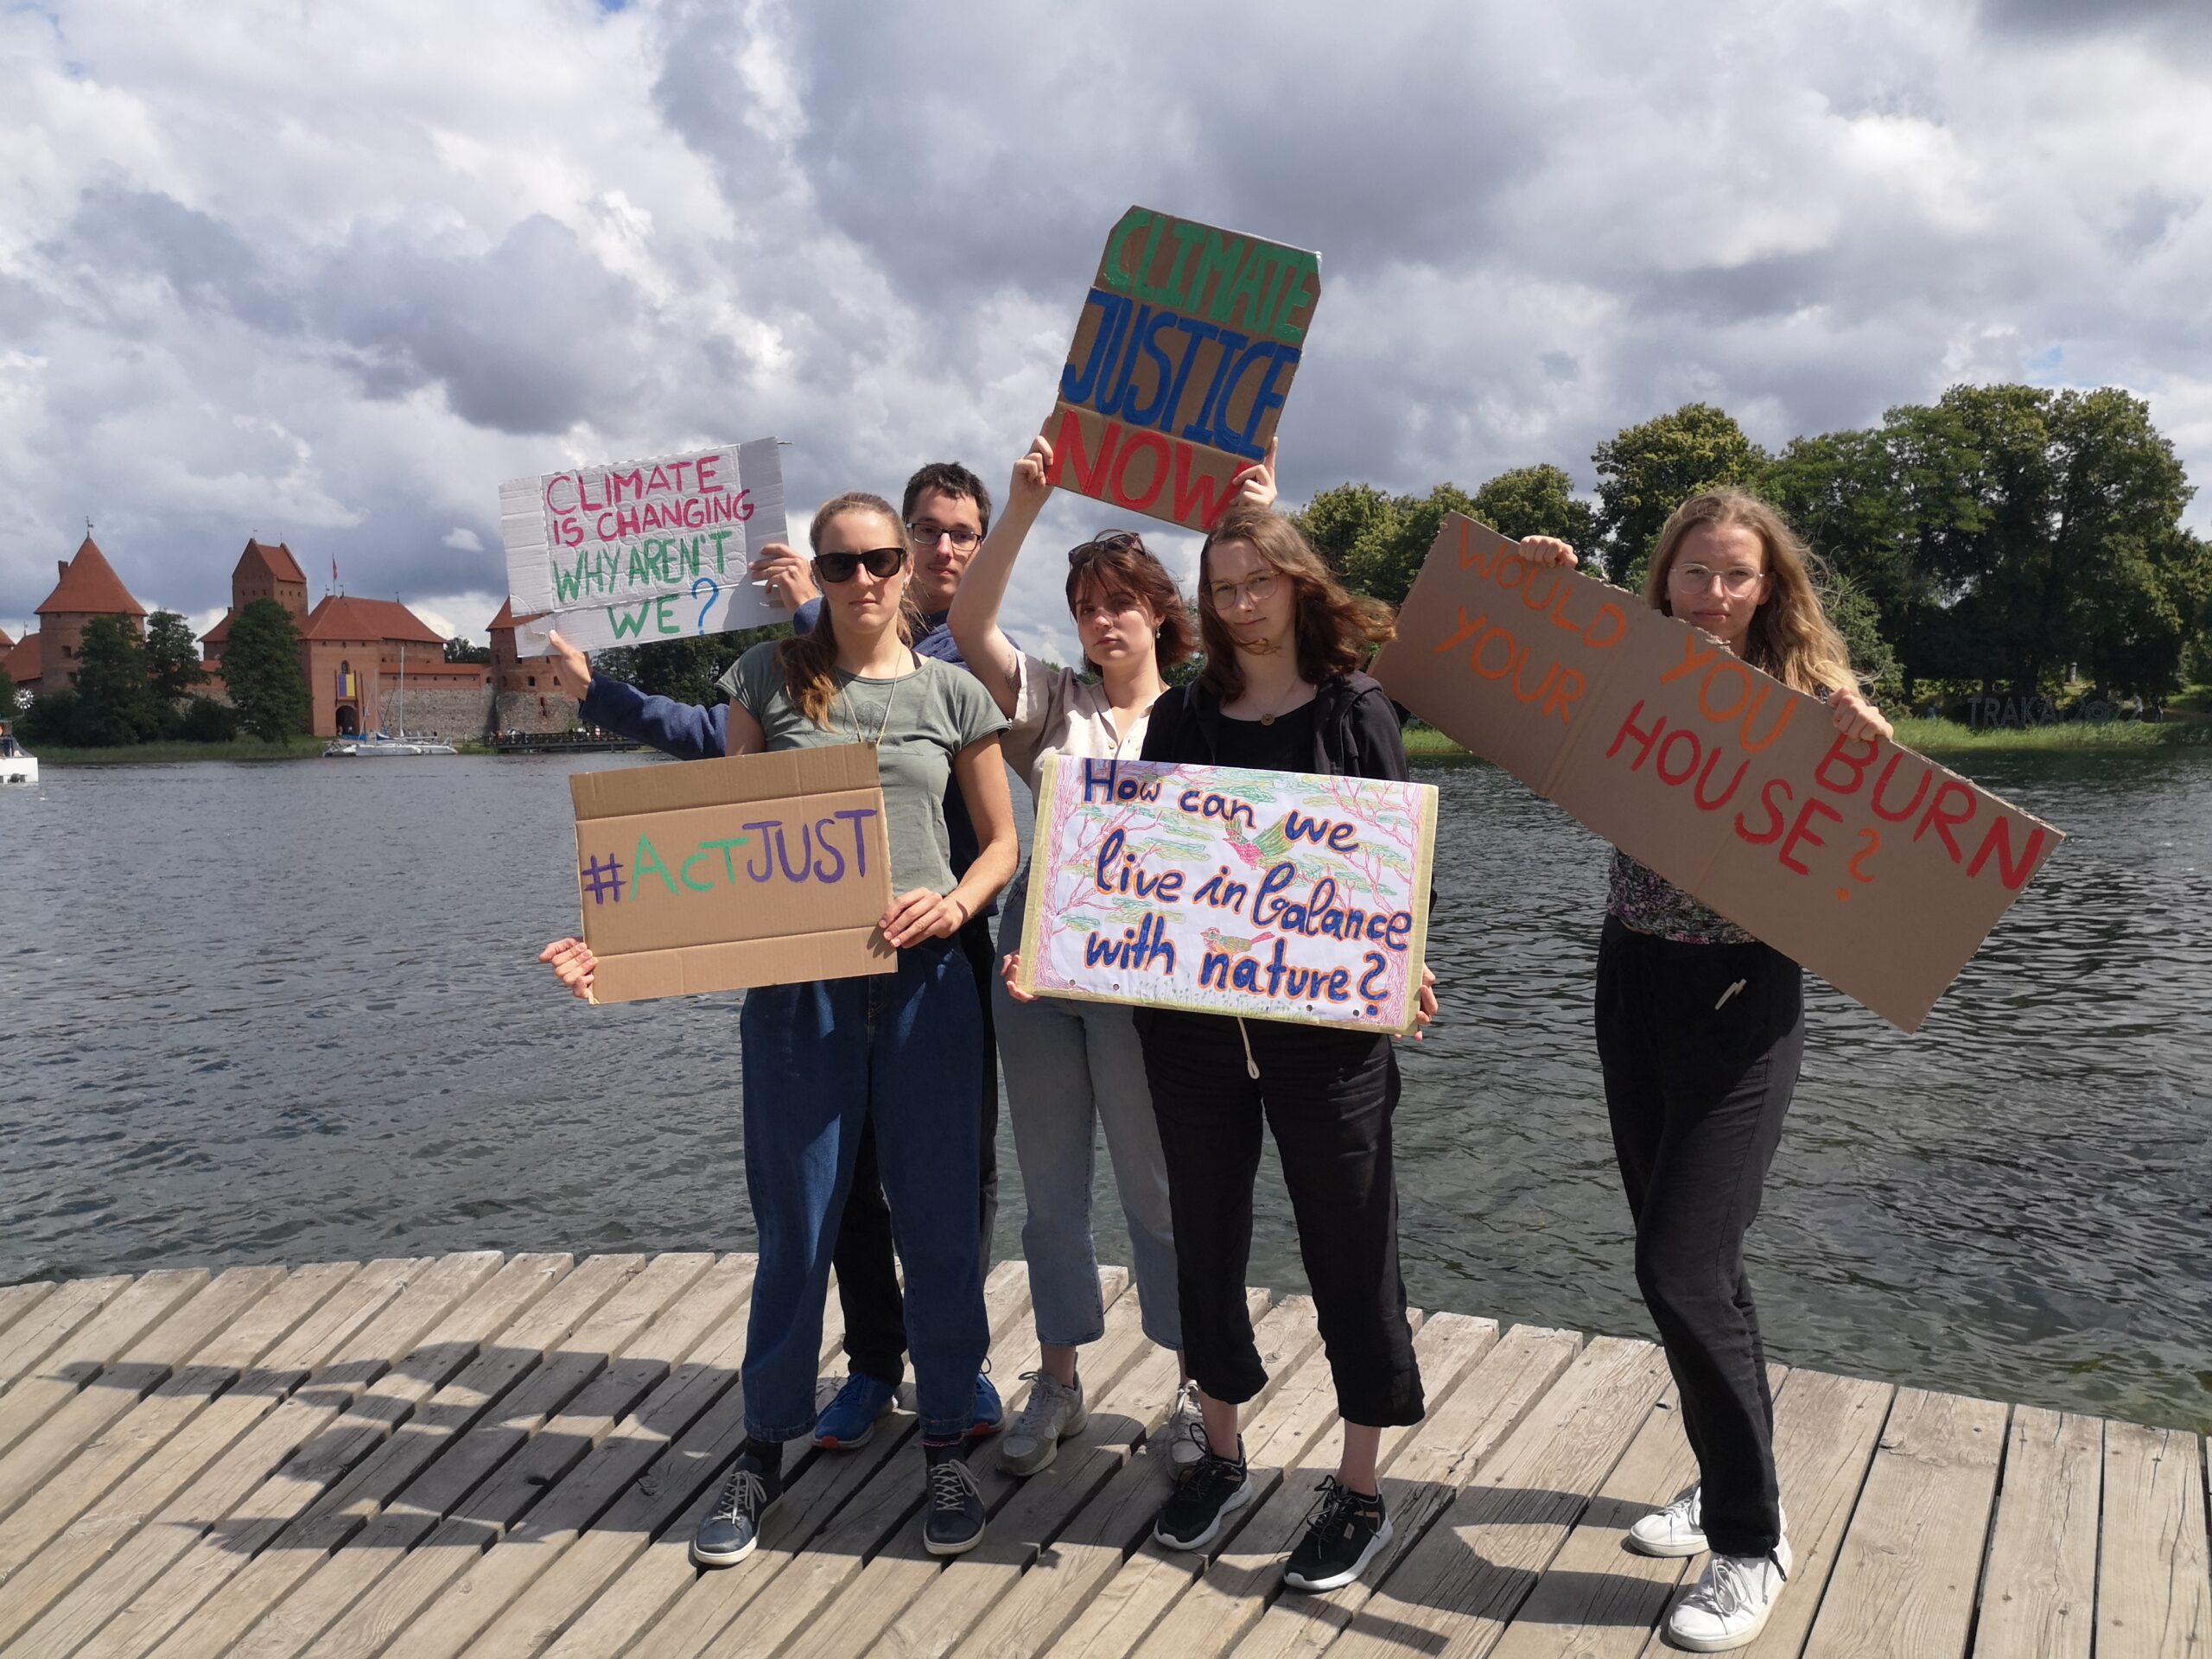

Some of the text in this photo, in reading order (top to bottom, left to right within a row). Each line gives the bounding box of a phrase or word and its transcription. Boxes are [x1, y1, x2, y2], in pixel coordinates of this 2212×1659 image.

[1103, 210, 1319, 344] CLIMATE
[1061, 289, 1303, 461] JUSTICE
[546, 455, 724, 516] CLIMATE
[553, 489, 754, 548] IS CHANGING
[1046, 409, 1255, 530] NOW
[553, 531, 733, 602] WHY AREN'T
[1432, 605, 1587, 726] YOUR
[1460, 519, 2045, 891] WOULD YOU BURN
[1081, 758, 1359, 853] How can we
[1095, 827, 1412, 951] live in balance
[1084, 912, 1391, 1018] with nature?
